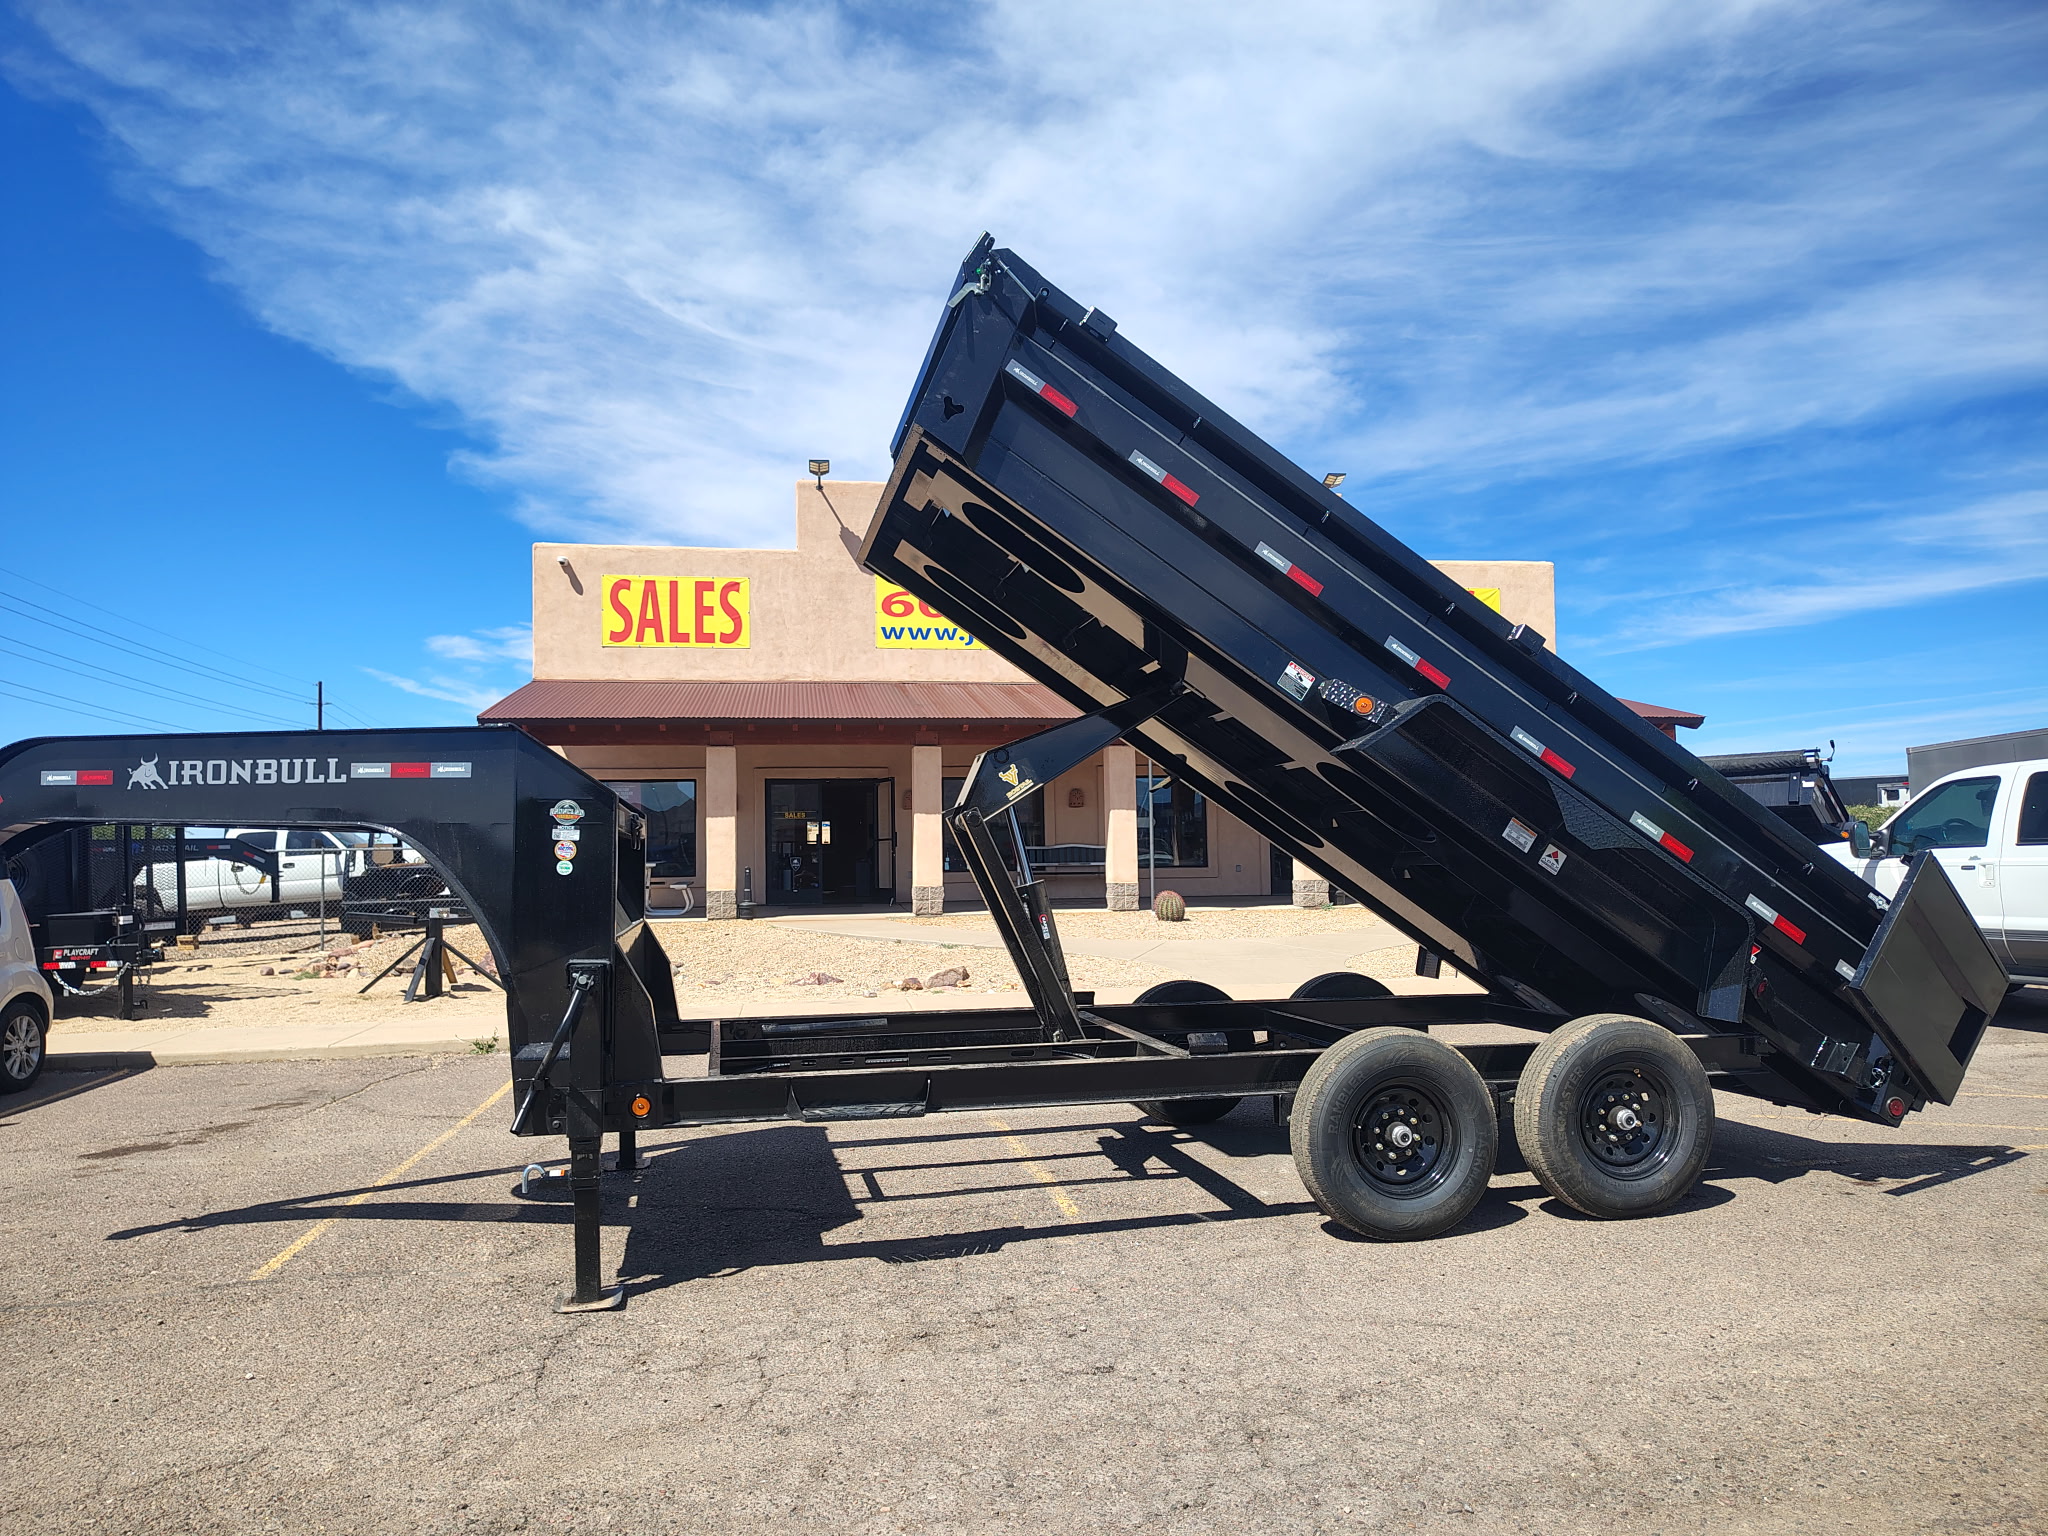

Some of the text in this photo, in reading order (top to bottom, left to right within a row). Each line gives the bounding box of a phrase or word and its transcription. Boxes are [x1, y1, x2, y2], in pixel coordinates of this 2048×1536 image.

[609, 578, 743, 644] SALES
[168, 758, 347, 785] IRONBULL
[63, 948, 99, 957] PLAYCRAFT
[1327, 1070, 1366, 1134] RAMBLER
